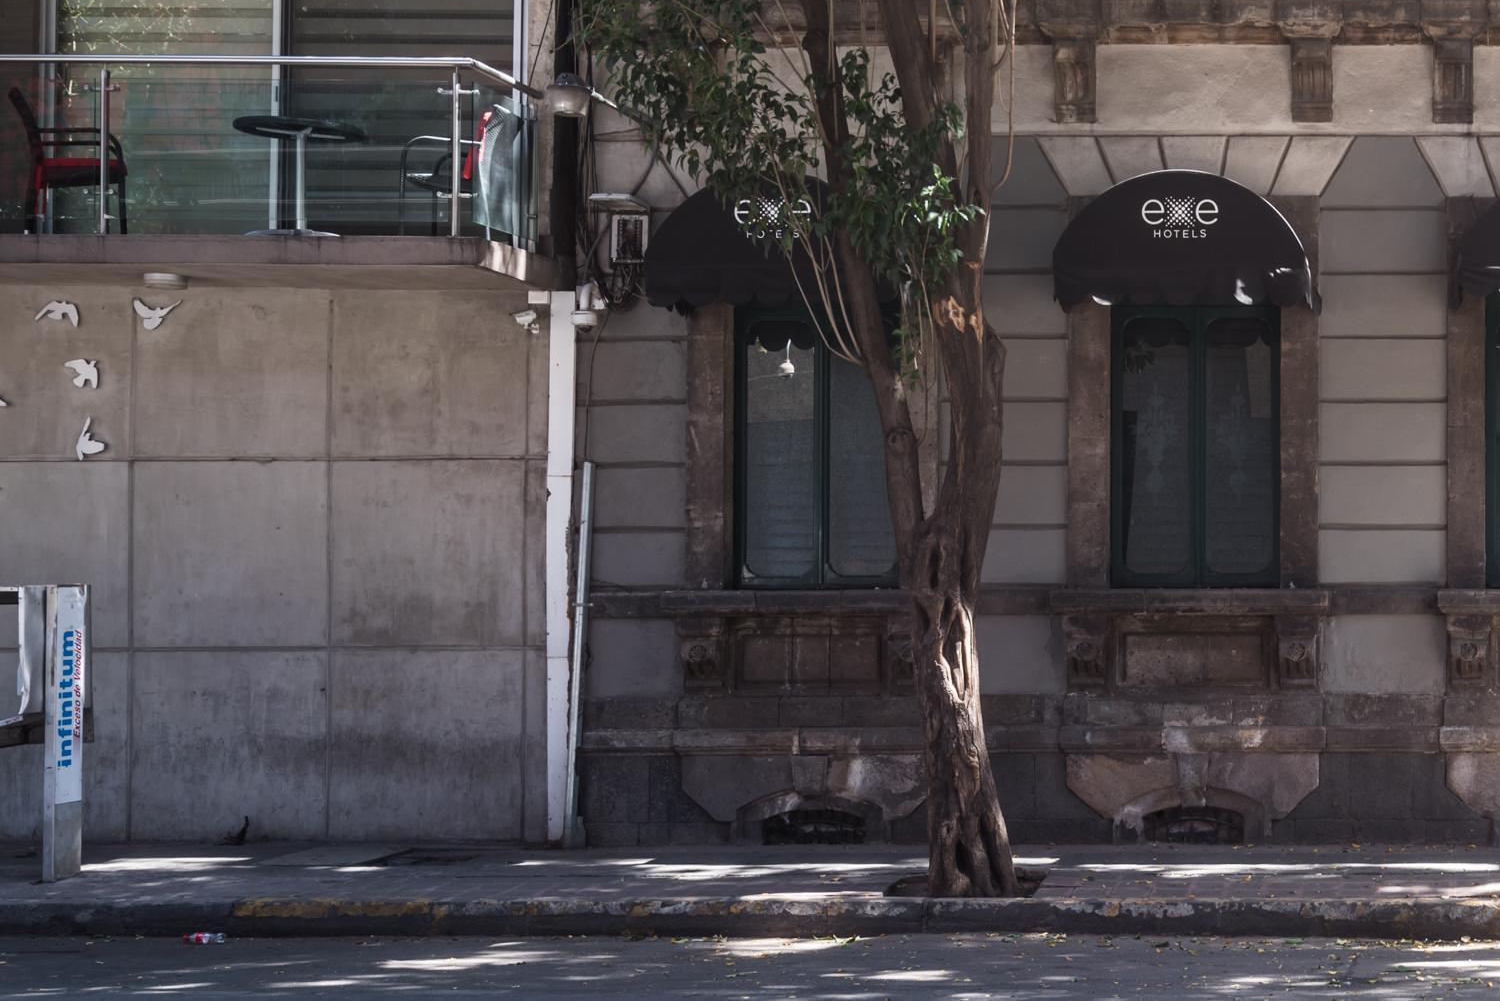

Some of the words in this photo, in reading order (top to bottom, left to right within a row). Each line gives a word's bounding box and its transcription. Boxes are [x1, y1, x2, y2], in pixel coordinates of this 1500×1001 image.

[1153, 228, 1207, 239] HOTELS
[73, 629, 83, 682] Velocidad
[57, 630, 75, 768] infinitum
[73, 684, 82, 698] de
[73, 700, 82, 739] Exceso
